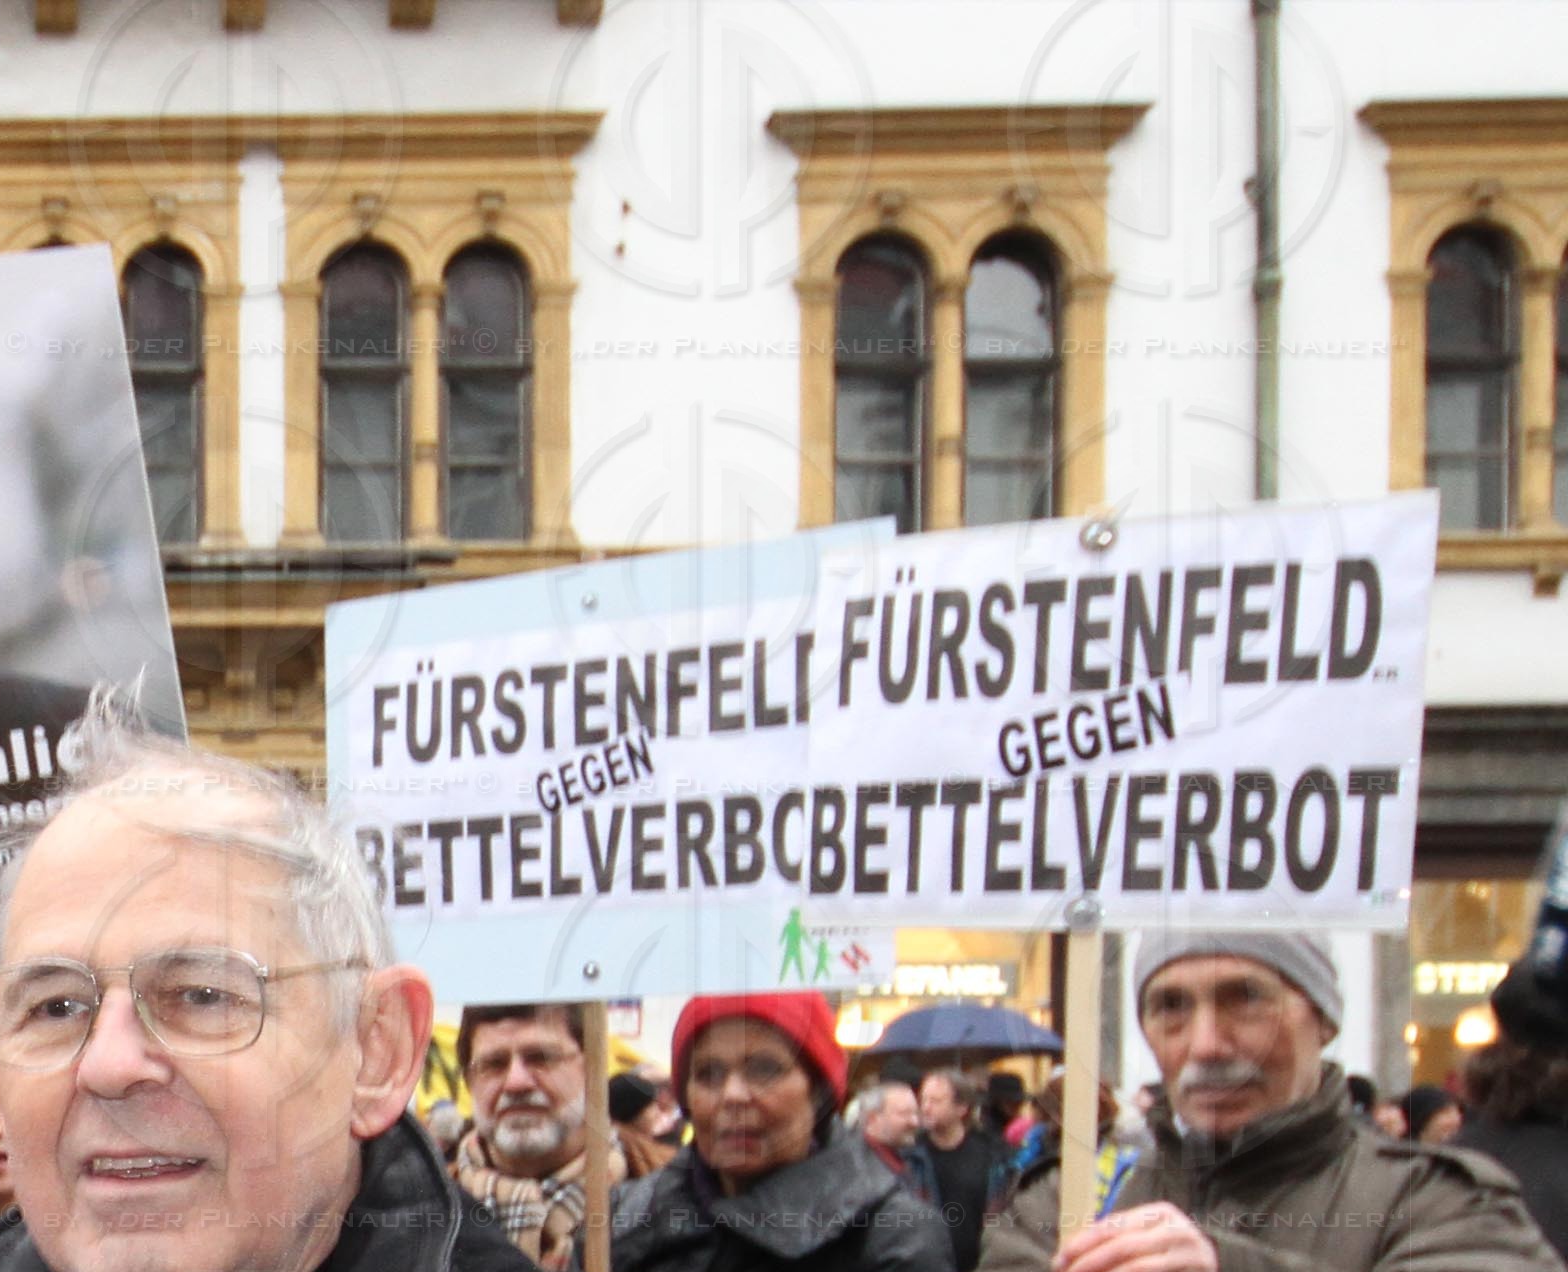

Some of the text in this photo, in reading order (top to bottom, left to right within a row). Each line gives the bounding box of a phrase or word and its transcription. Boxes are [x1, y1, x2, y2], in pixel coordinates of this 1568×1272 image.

[838, 557, 1383, 708] FÜRSTENFELD
[536, 728, 654, 814] GEGEN
[999, 684, 1177, 777] GEGEN
[809, 765, 1401, 895] BETTELVERBOT
